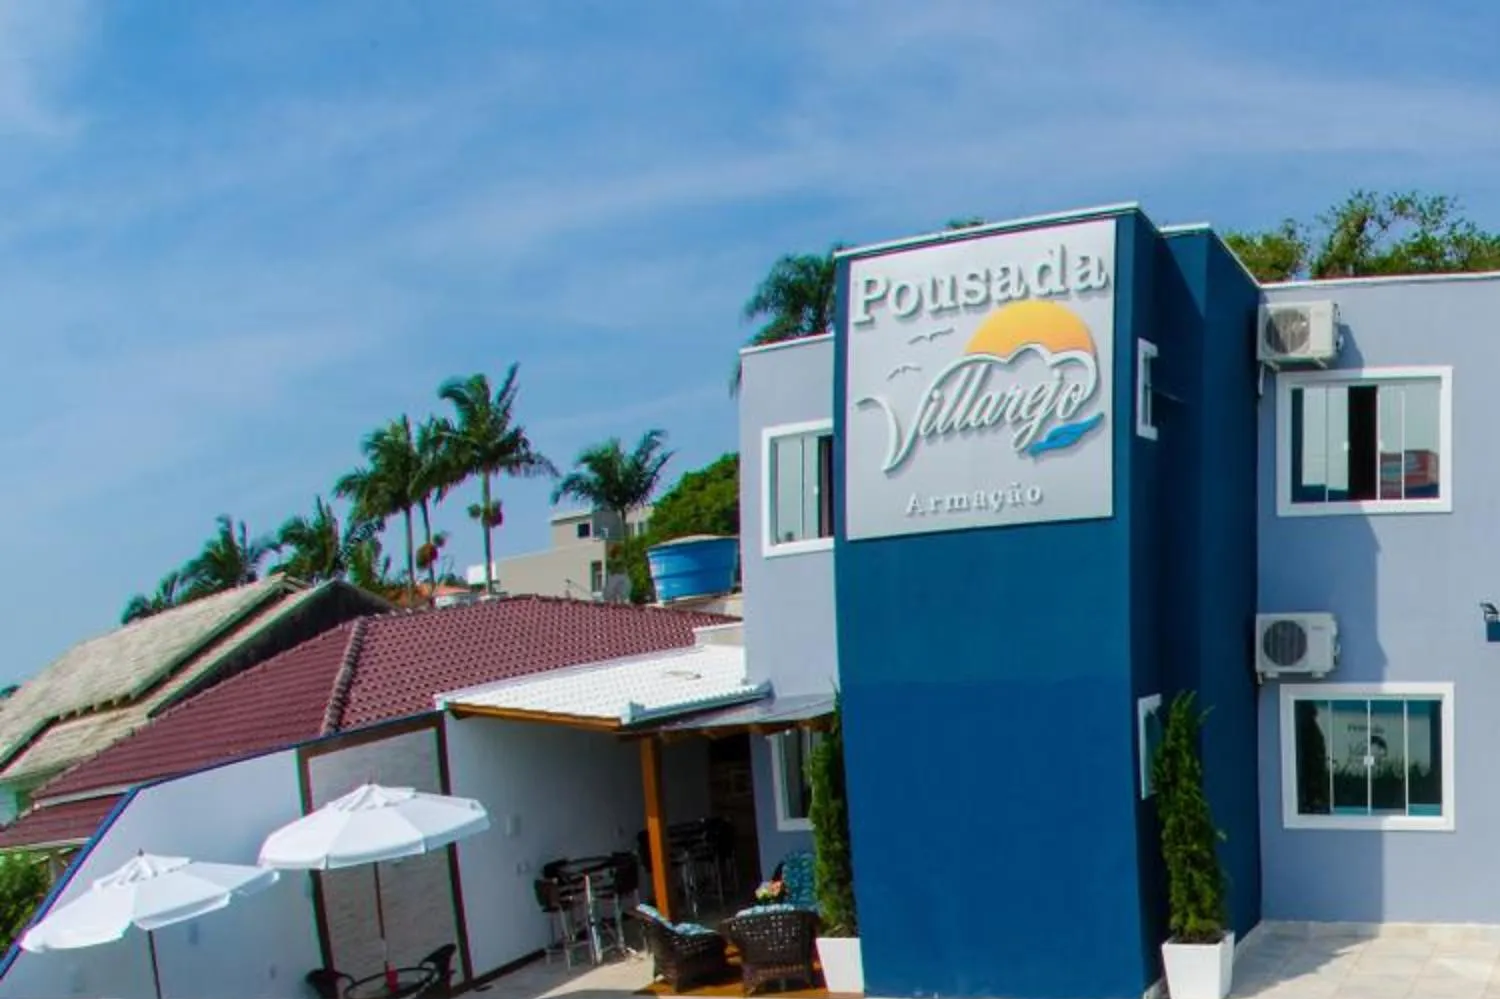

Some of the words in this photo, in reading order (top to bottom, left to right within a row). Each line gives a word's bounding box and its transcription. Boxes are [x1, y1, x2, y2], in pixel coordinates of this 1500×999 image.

[853, 246, 1110, 326] Pousada
[856, 344, 1098, 473] Villarejo
[906, 483, 1043, 516] Armação
